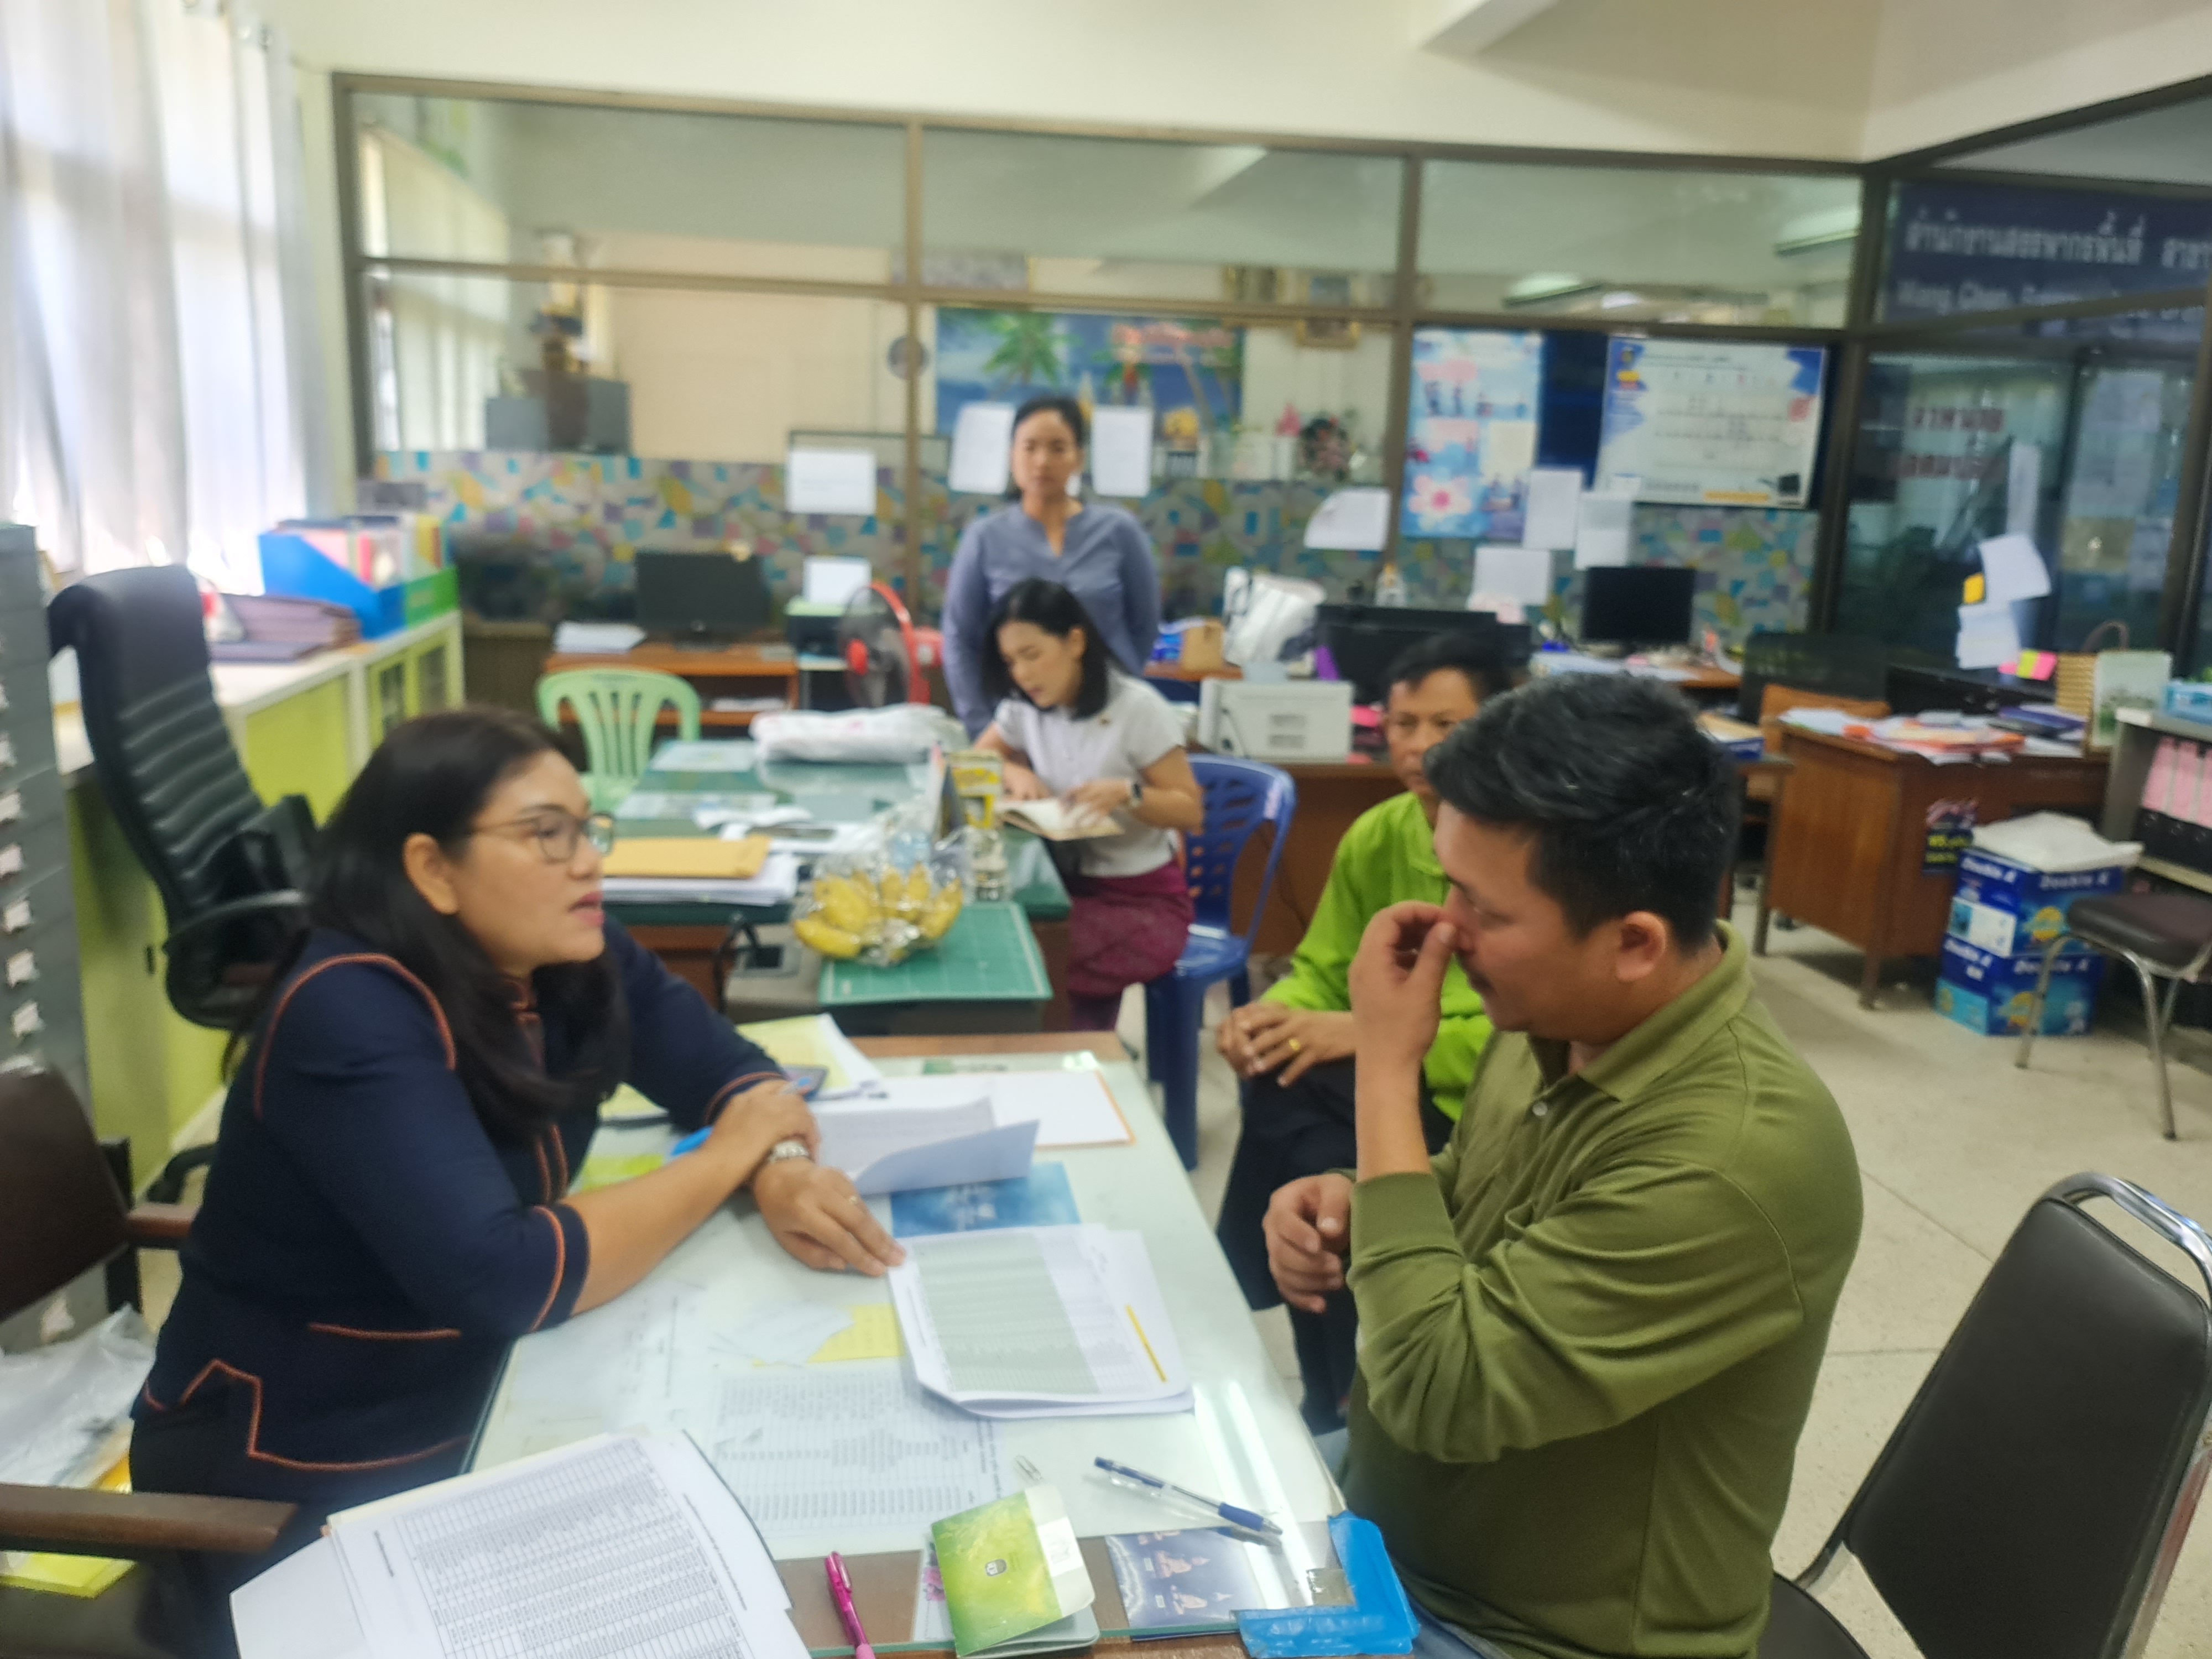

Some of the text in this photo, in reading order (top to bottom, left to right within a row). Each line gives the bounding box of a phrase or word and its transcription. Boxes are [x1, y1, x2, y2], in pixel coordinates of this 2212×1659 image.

[2039, 870, 2110, 889] Double A
[2013, 958, 2089, 975] Doule A
